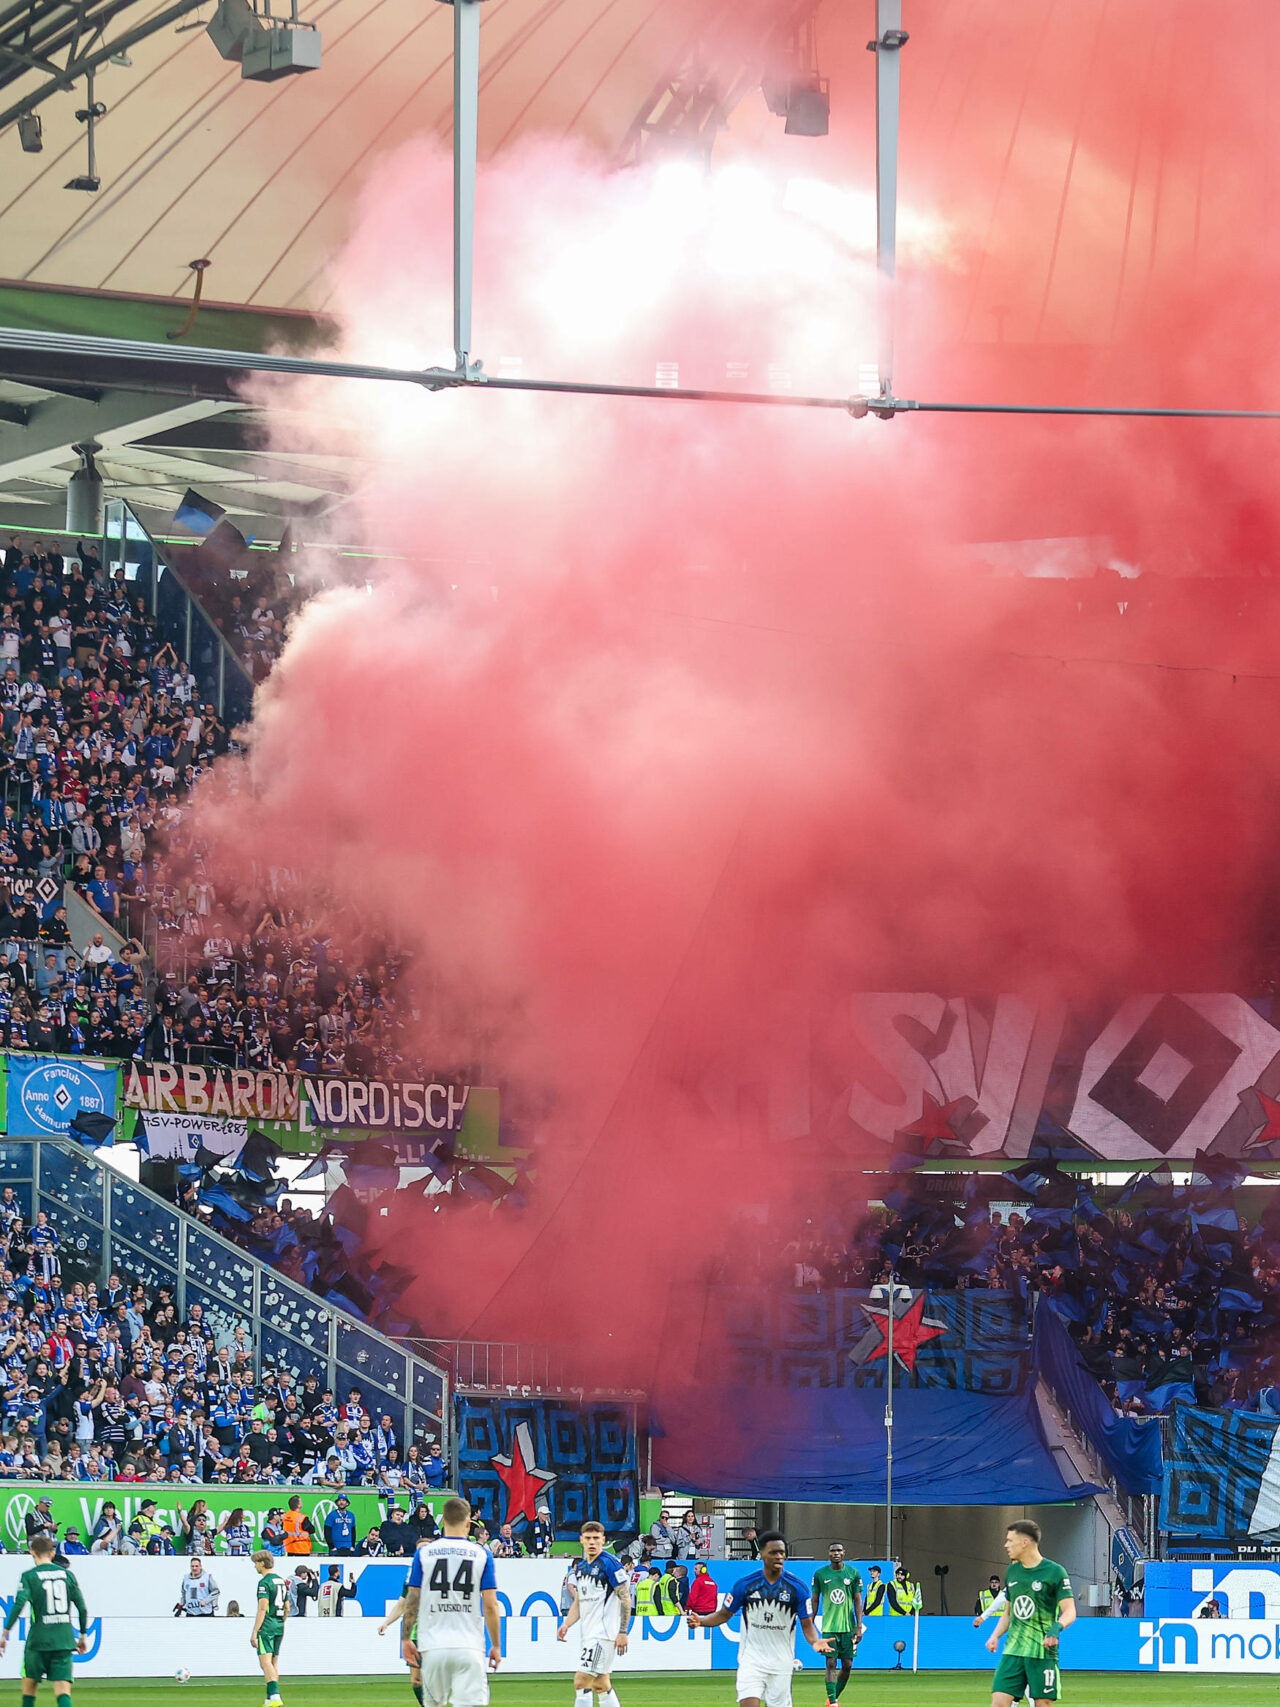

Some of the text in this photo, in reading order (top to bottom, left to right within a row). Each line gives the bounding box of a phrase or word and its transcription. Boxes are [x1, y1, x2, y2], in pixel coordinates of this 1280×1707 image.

[43, 1068, 81, 1086] Fanclub
[25, 1090, 100, 1108] Anno 1887
[1238, 1545, 1258, 1553] DU
[430, 1558, 474, 1600] 44
[42, 1580, 68, 1614] 19
[581, 1647, 594, 1663] 21
